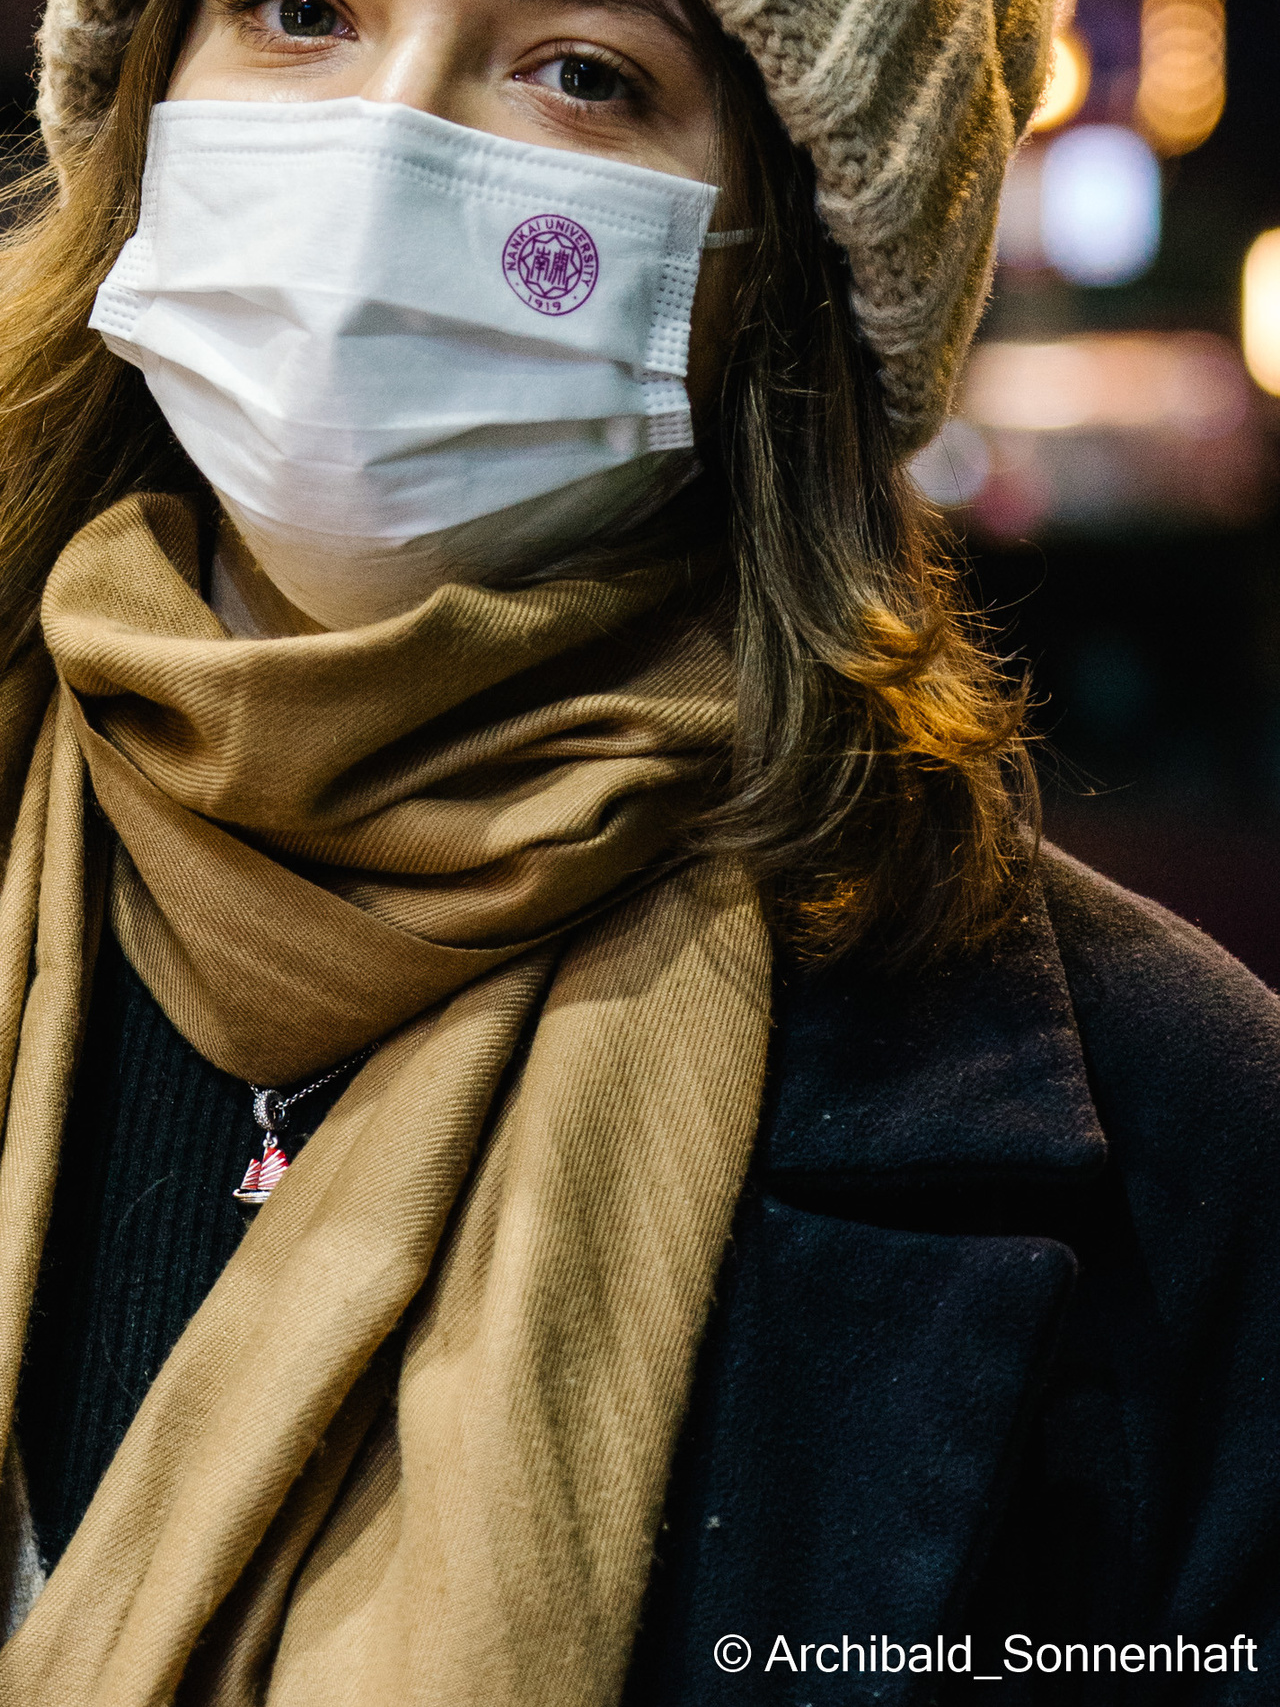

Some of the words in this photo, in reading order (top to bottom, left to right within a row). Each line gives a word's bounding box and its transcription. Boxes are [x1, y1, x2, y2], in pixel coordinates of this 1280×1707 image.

[506, 220, 541, 271] NANKAI
[545, 219, 594, 287] UNIVERSITY
[528, 295, 561, 311] 1919
